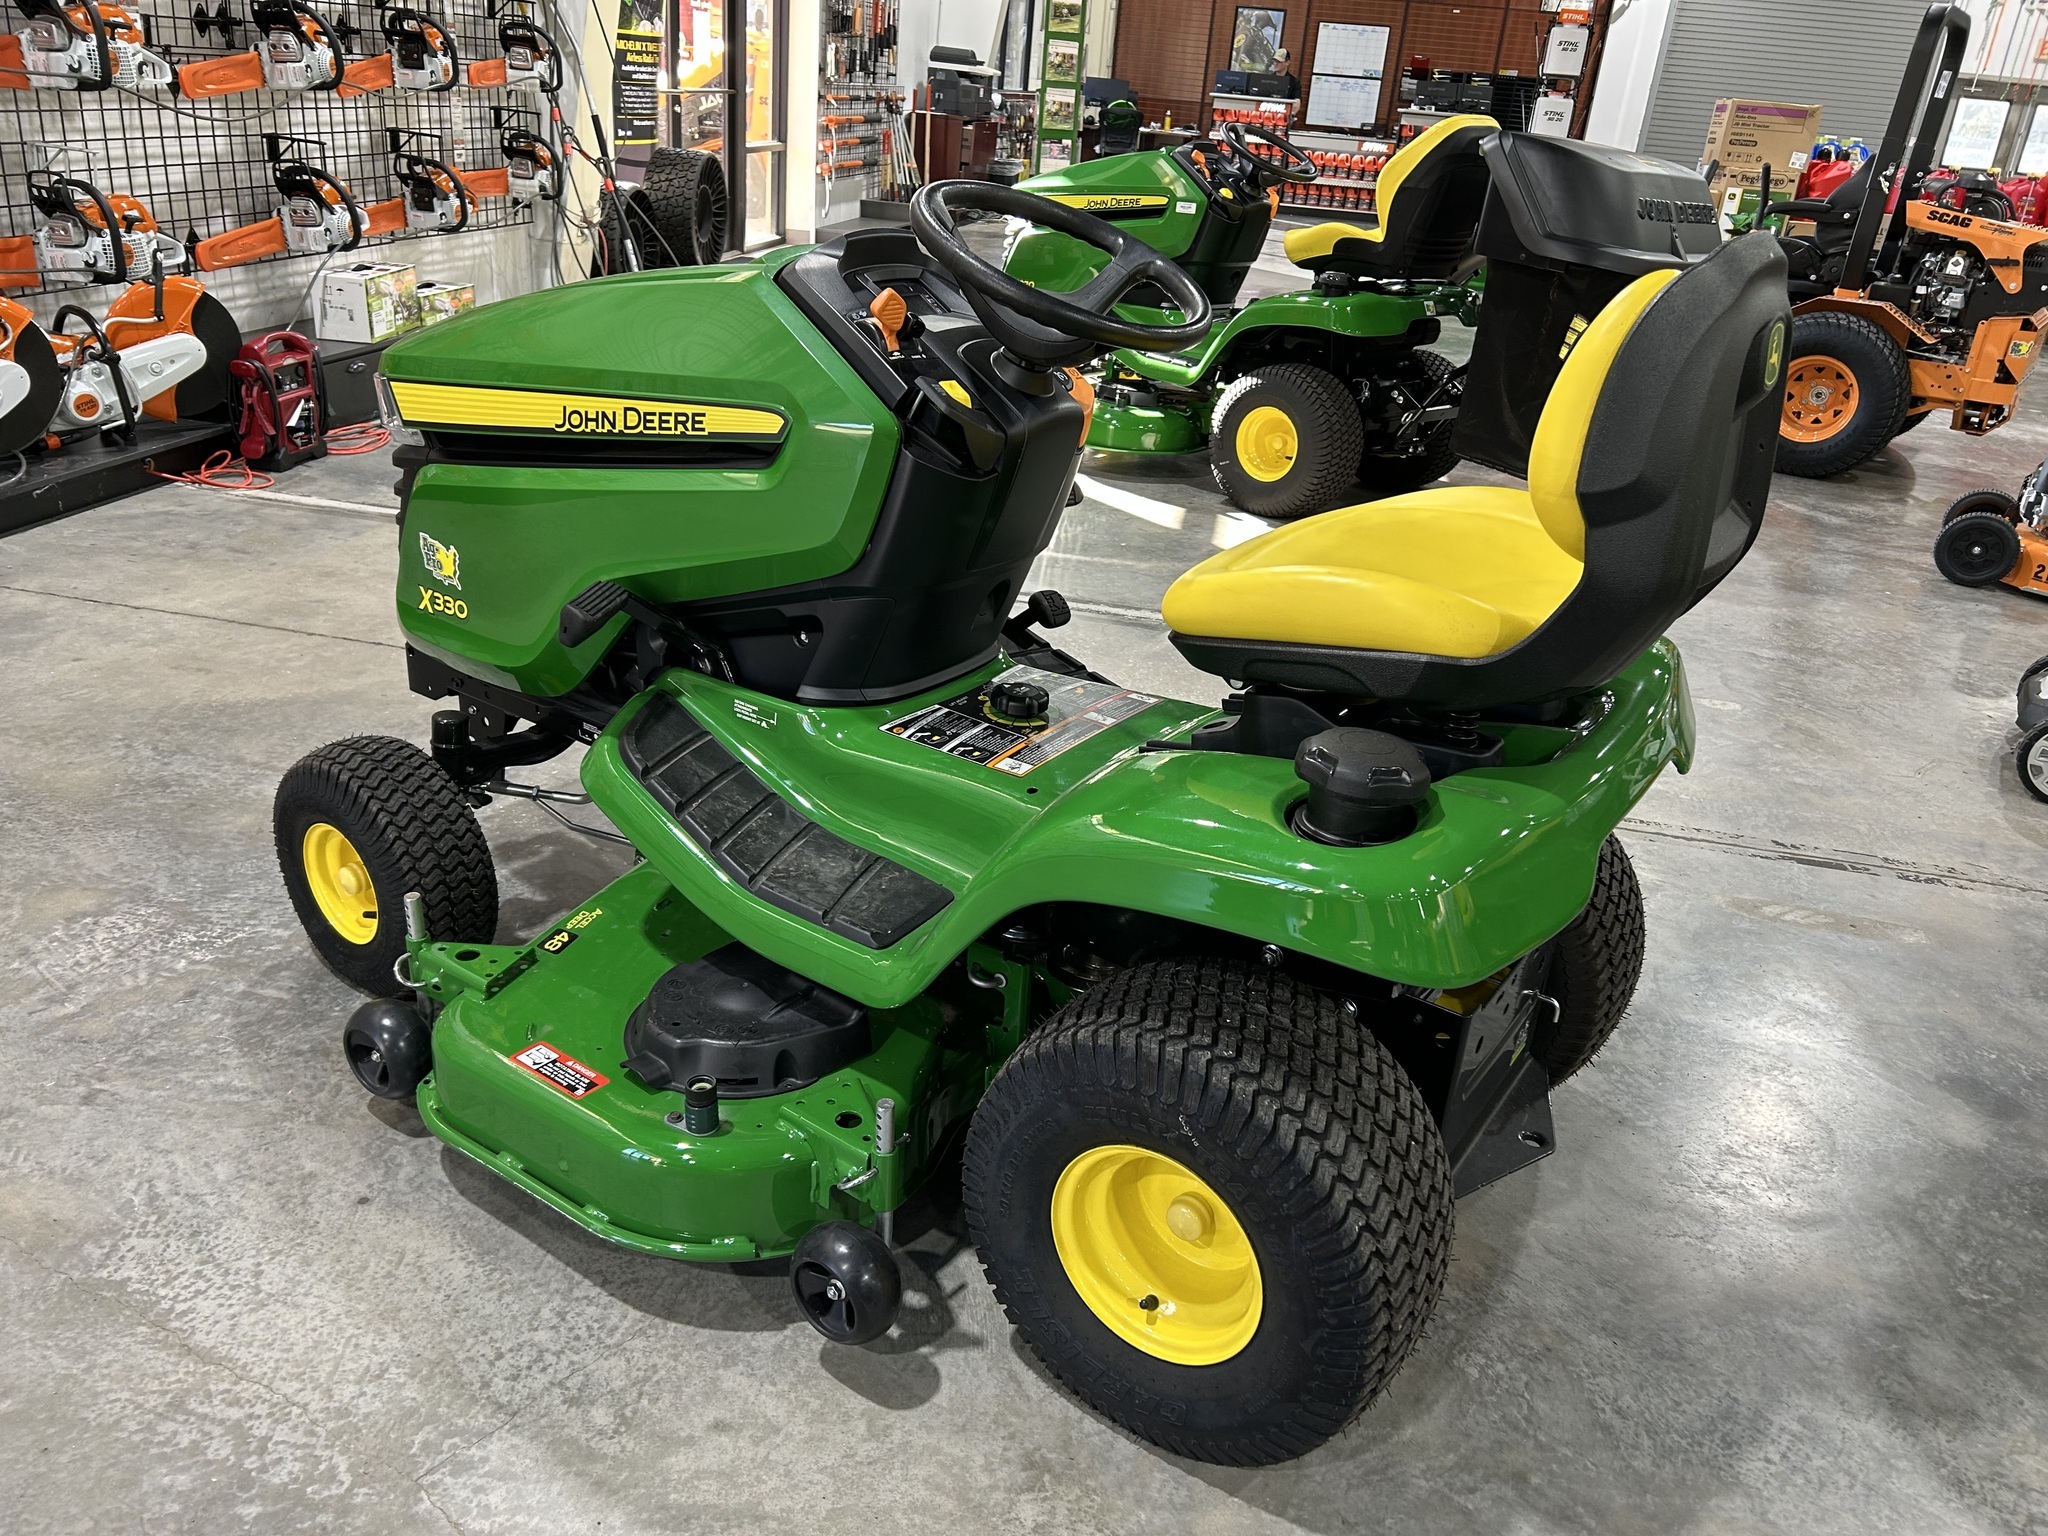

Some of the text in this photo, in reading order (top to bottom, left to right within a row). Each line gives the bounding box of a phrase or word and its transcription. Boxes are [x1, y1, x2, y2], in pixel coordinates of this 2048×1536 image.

[1361, 142, 1389, 152] STIHL
[1083, 198, 1141, 209] JOHN DEERE
[1637, 198, 1717, 224] JOHN DEERE
[1927, 210, 1973, 228] SCAG
[76, 398, 96, 410] STIHL
[555, 406, 707, 433] JOHN DEERE
[419, 586, 468, 619] X330
[566, 911, 590, 929] DEEP
[575, 908, 602, 928] ACCEL
[544, 932, 569, 951] 48
[572, 1063, 597, 1078] DANGER
